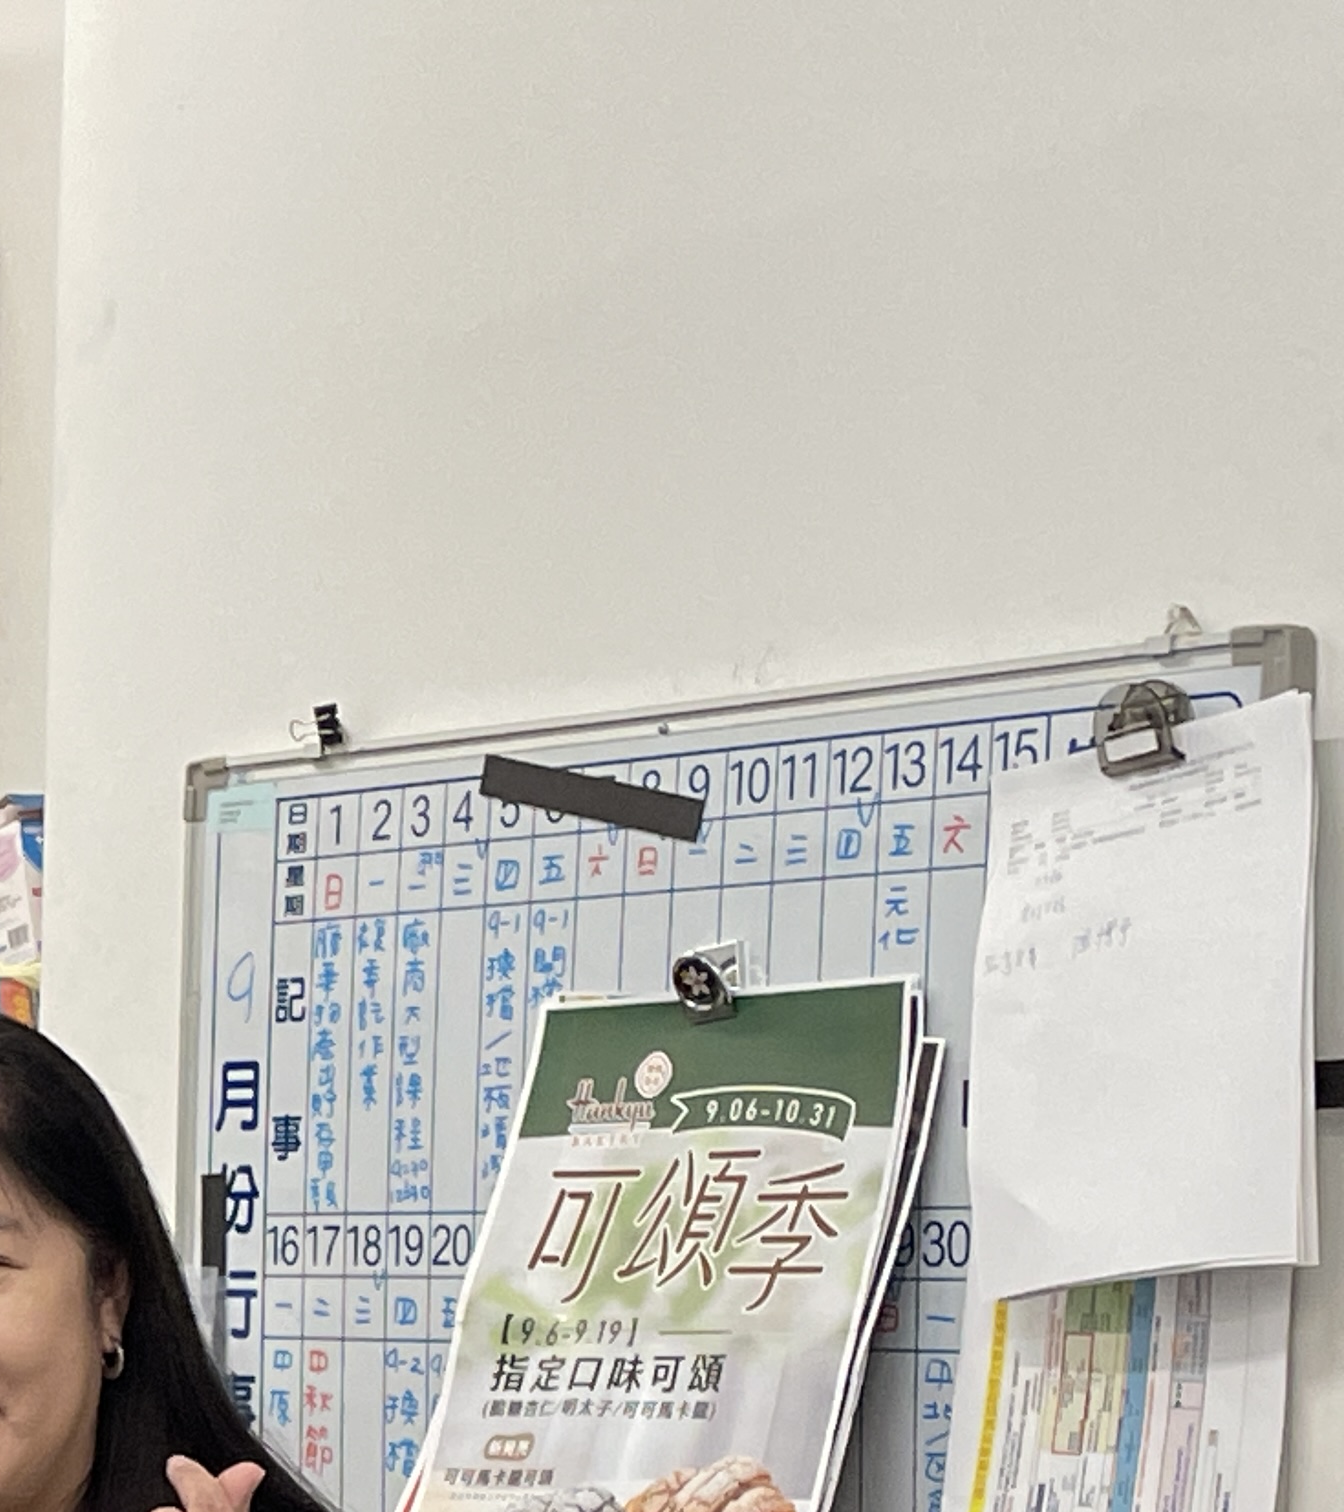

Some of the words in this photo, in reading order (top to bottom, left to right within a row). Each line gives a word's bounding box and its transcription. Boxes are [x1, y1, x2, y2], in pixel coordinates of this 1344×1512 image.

[782, 752, 818, 801] 11
[833, 746, 874, 796] 12
[883, 740, 926, 790] 13
[938, 734, 983, 785] 14
[729, 757, 771, 806] 10
[328, 804, 344, 846] 1
[371, 799, 393, 842] 2
[411, 794, 431, 838] 3
[452, 789, 474, 834] 4
[706, 1098, 837, 1130] 9.06-10.31
[266, 1225, 300, 1266] 16
[307, 1225, 341, 1267] 17
[346, 1225, 382, 1267] 18
[388, 1225, 424, 1267] 19
[432, 1224, 472, 1267] 20
[527, 1148, 850, 1313] 可頌季
[921, 1220, 970, 1268] 30
[490, 1353, 728, 1394] 指定口味可頌
